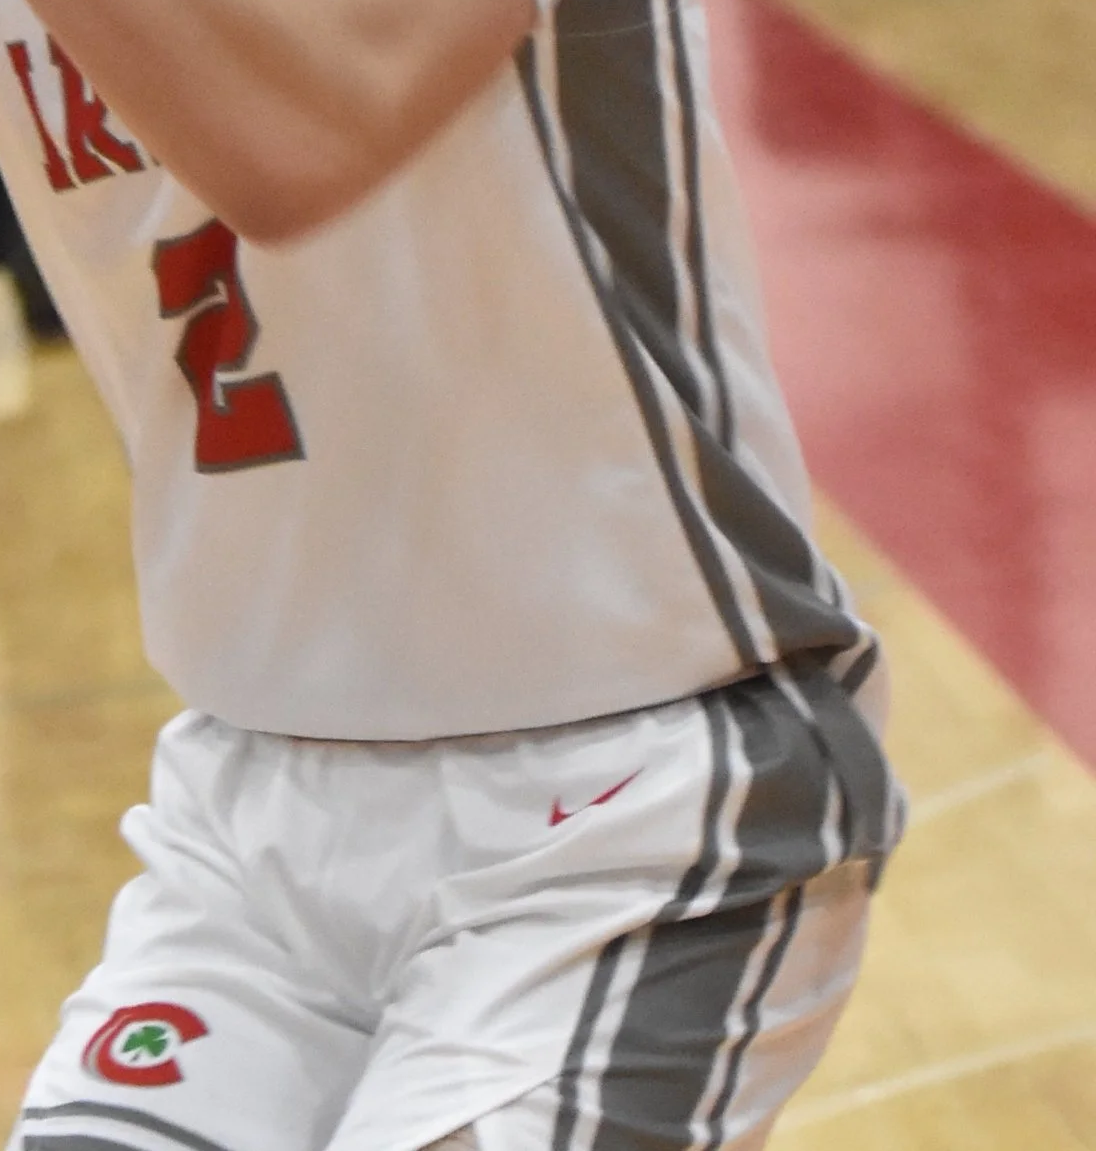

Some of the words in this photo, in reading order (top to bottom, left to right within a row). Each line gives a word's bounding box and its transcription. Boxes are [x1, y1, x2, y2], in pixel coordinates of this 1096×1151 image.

[5, 33, 161, 193] IR
[150, 216, 307, 474] 2
[80, 1001, 210, 1087] C
